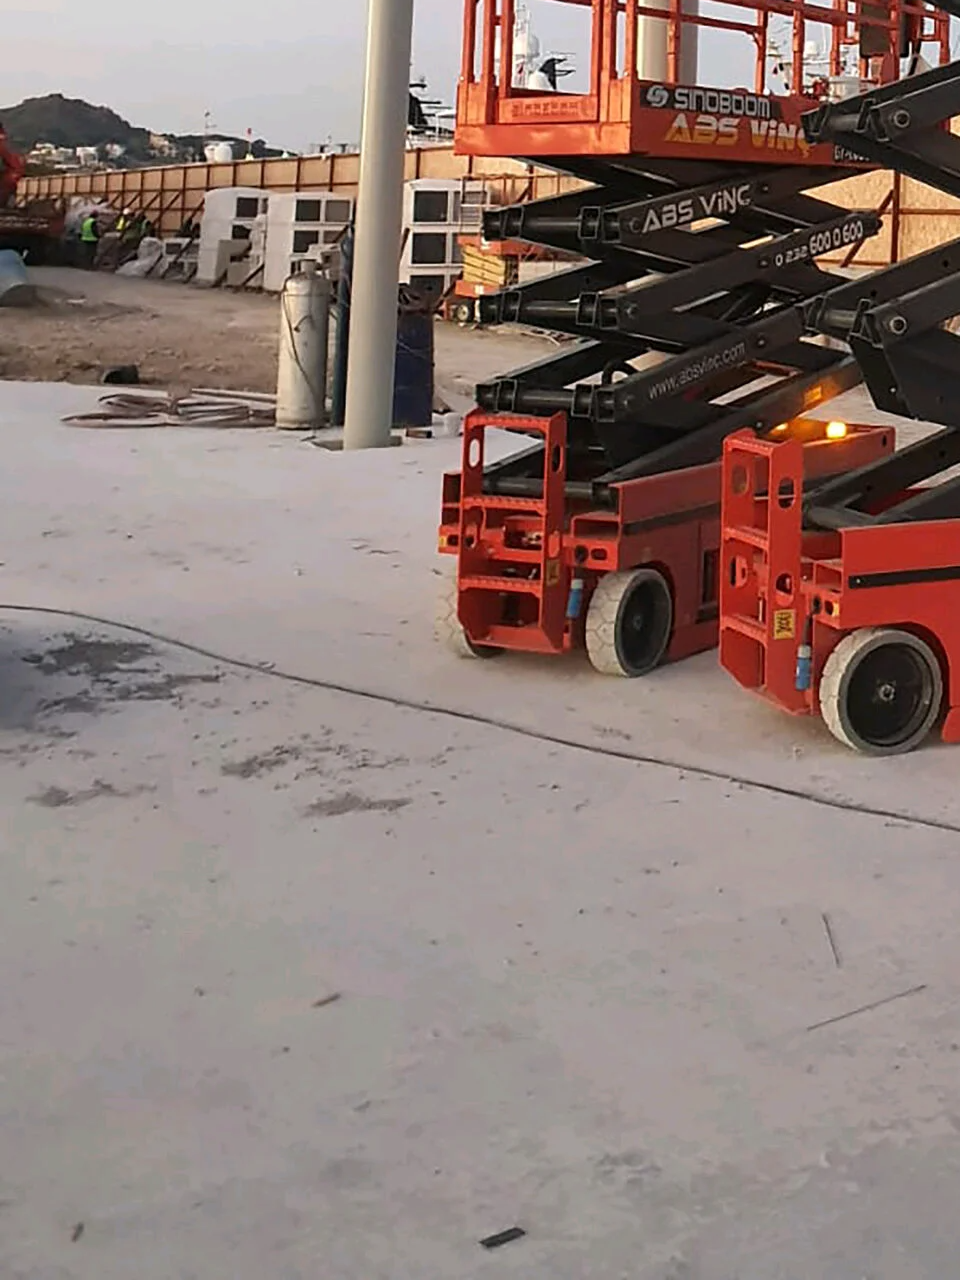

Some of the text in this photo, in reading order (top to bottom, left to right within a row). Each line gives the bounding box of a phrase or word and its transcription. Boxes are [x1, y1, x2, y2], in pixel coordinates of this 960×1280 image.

[674, 88, 771, 118] SINOBOOM
[664, 113, 742, 146] ABS
[642, 199, 693, 233] ABS
